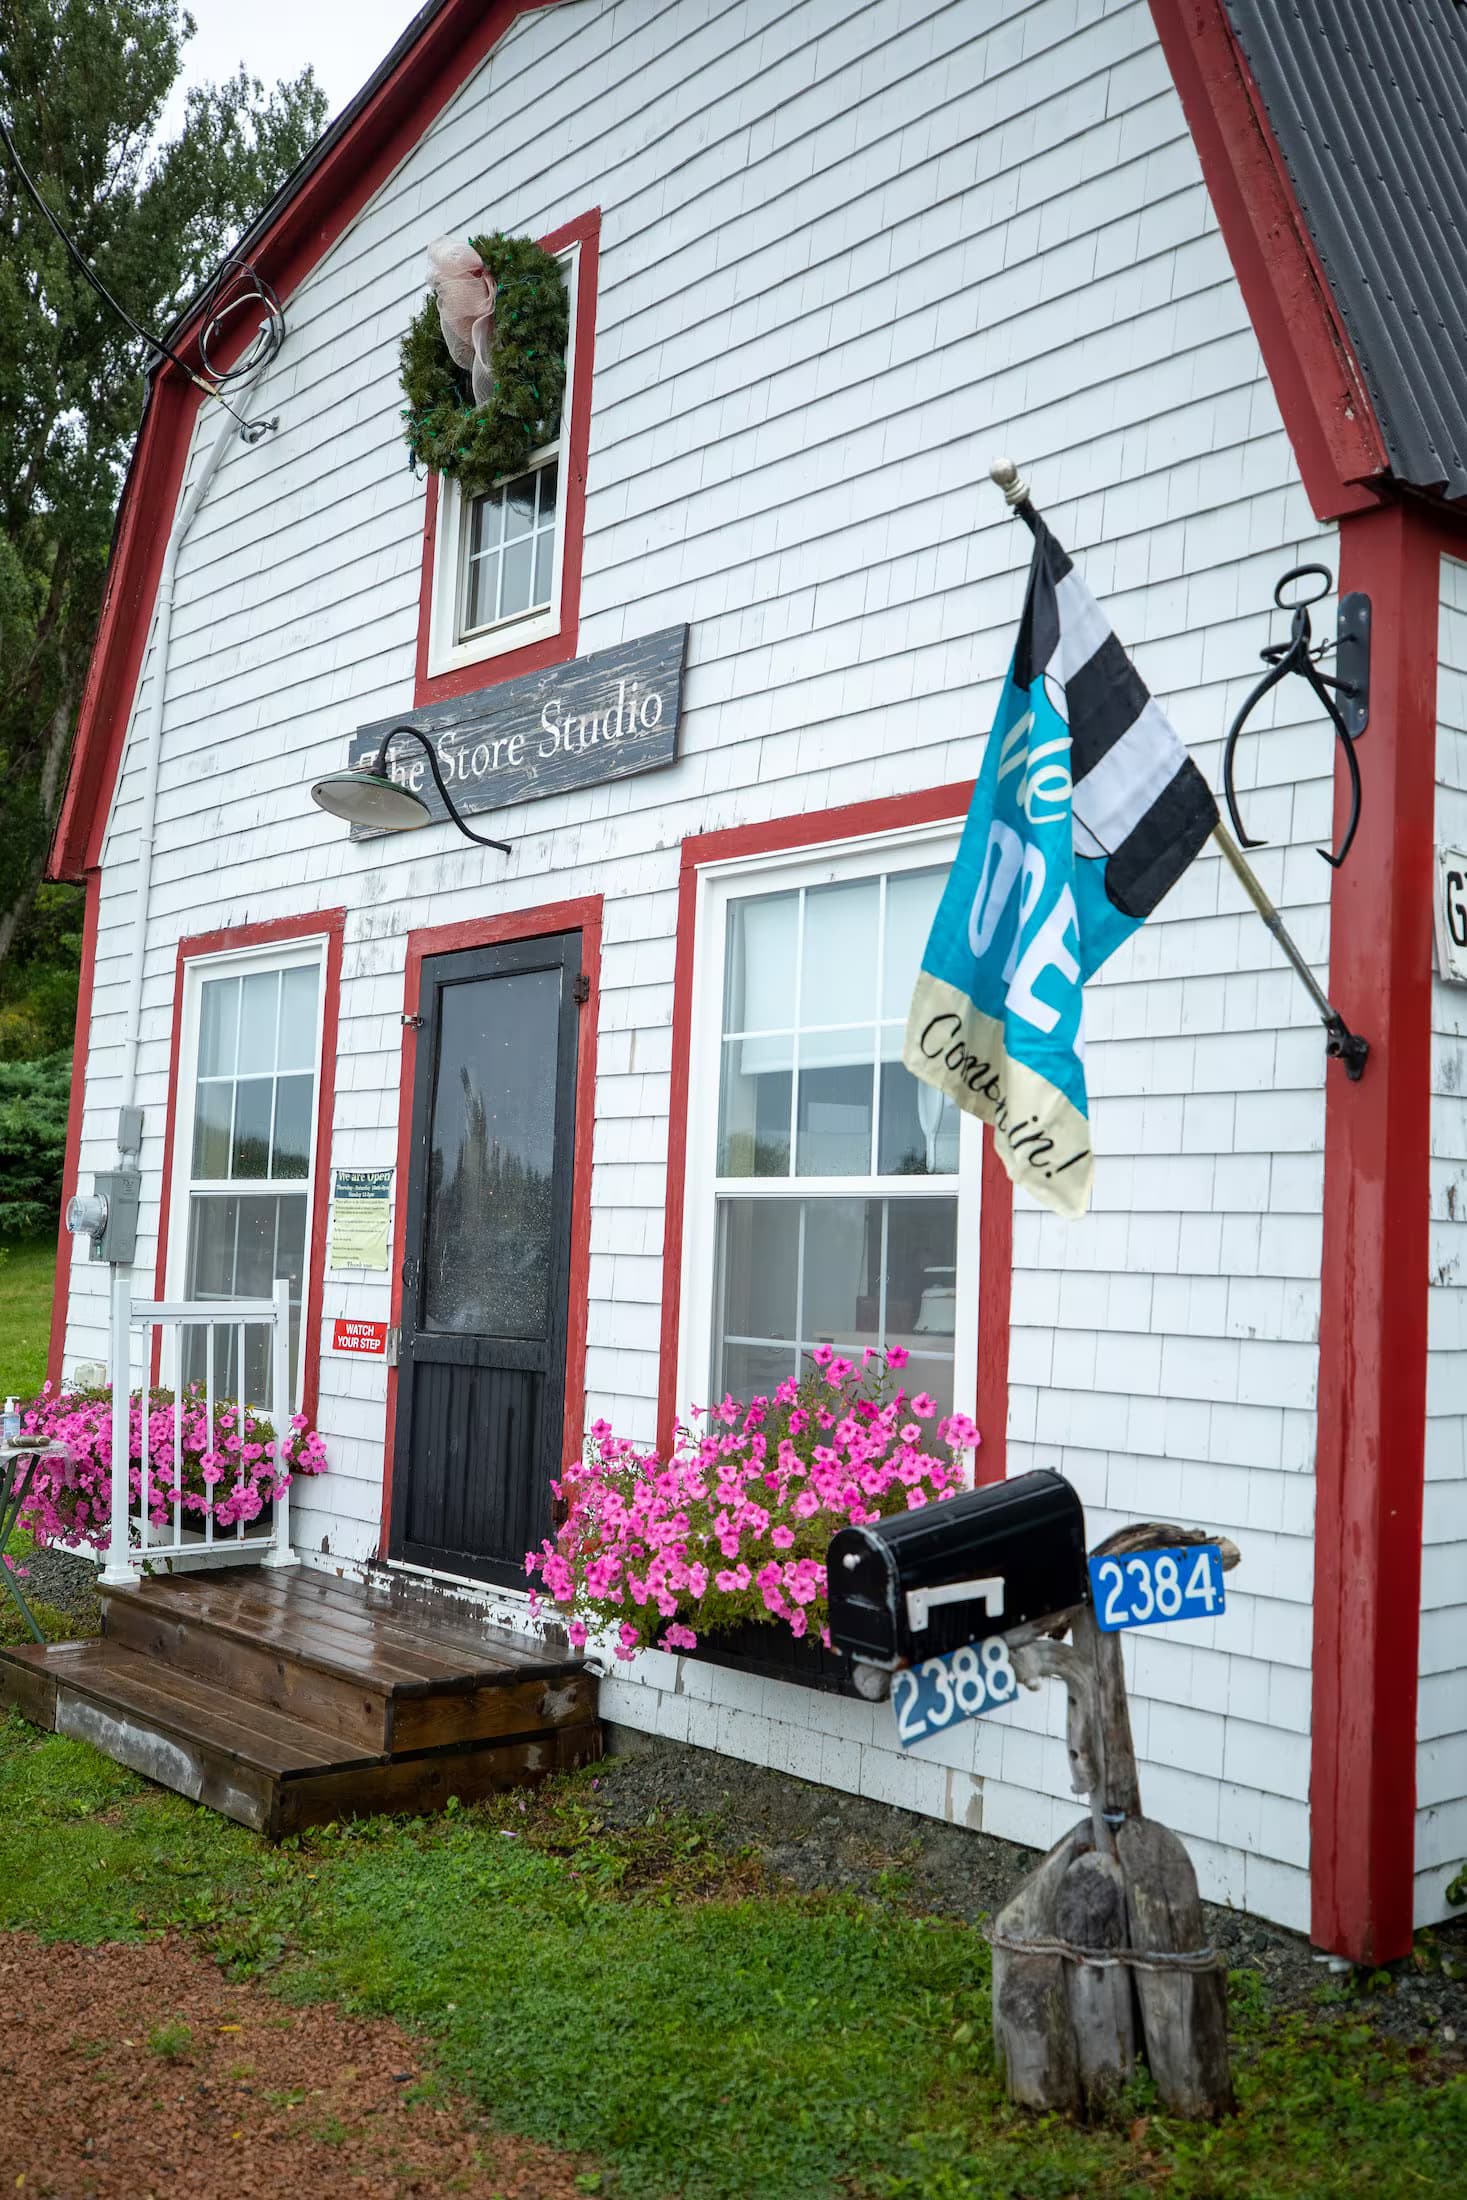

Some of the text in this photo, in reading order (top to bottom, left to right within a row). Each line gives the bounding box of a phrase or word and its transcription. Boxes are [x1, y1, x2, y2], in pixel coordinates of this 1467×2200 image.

[438, 730, 525, 785] Store
[538, 679, 664, 759] Studio
[967, 819, 1086, 1064] OPE
[1447, 870, 1467, 948] G
[339, 1171, 390, 1185] We are Open
[337, 1335, 381, 1350] YOUR STEP
[345, 1323, 375, 1337] WATCH
[1098, 1552, 1217, 1626] 2384
[890, 1636, 1017, 1742] 2388
